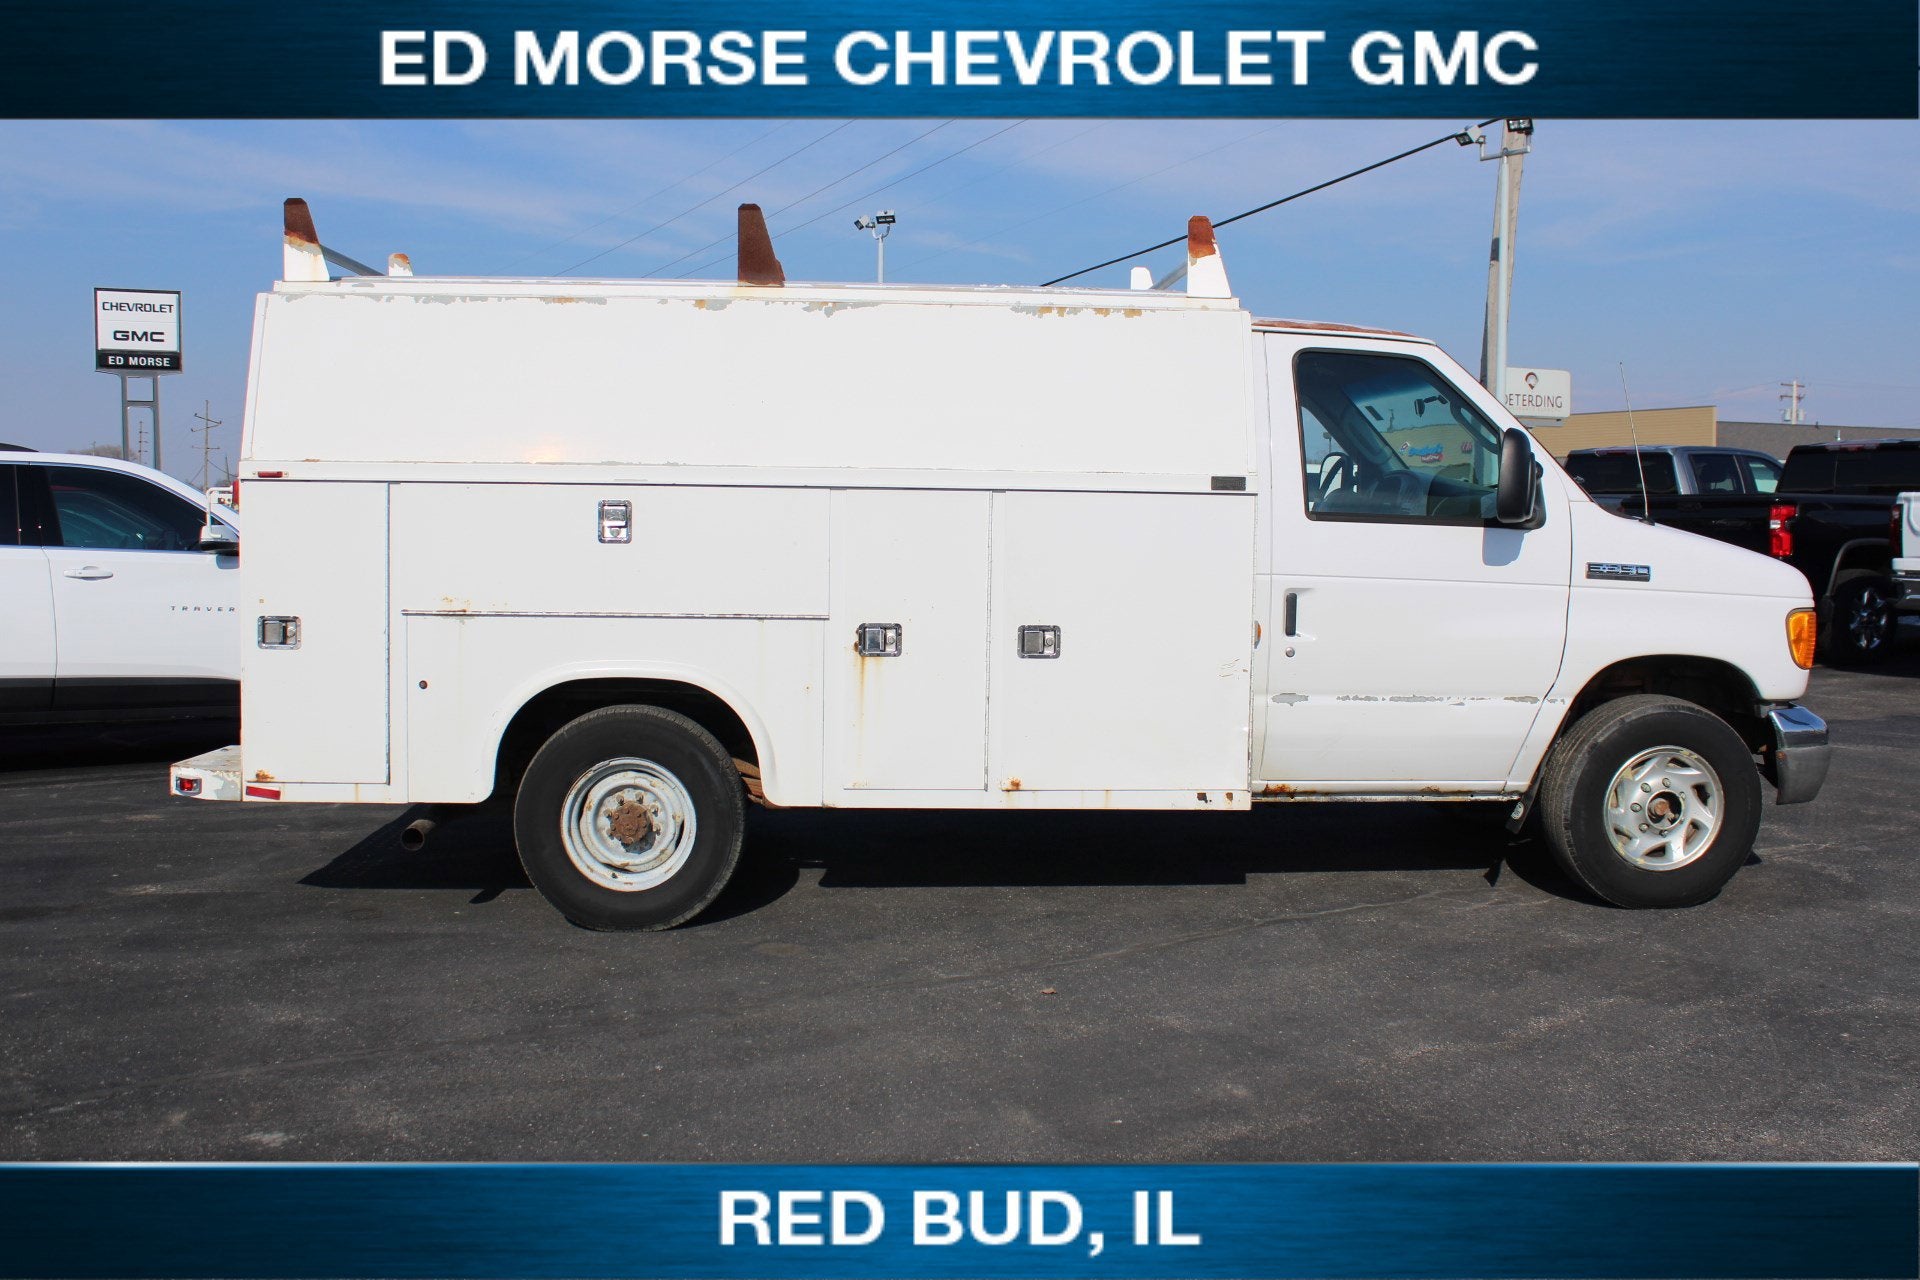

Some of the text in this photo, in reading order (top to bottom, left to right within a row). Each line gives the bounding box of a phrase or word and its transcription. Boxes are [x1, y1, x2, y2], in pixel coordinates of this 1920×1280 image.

[102, 301, 174, 313] CHEVROLET
[113, 330, 165, 342] GMC
[108, 355, 170, 367] ED MORSE
